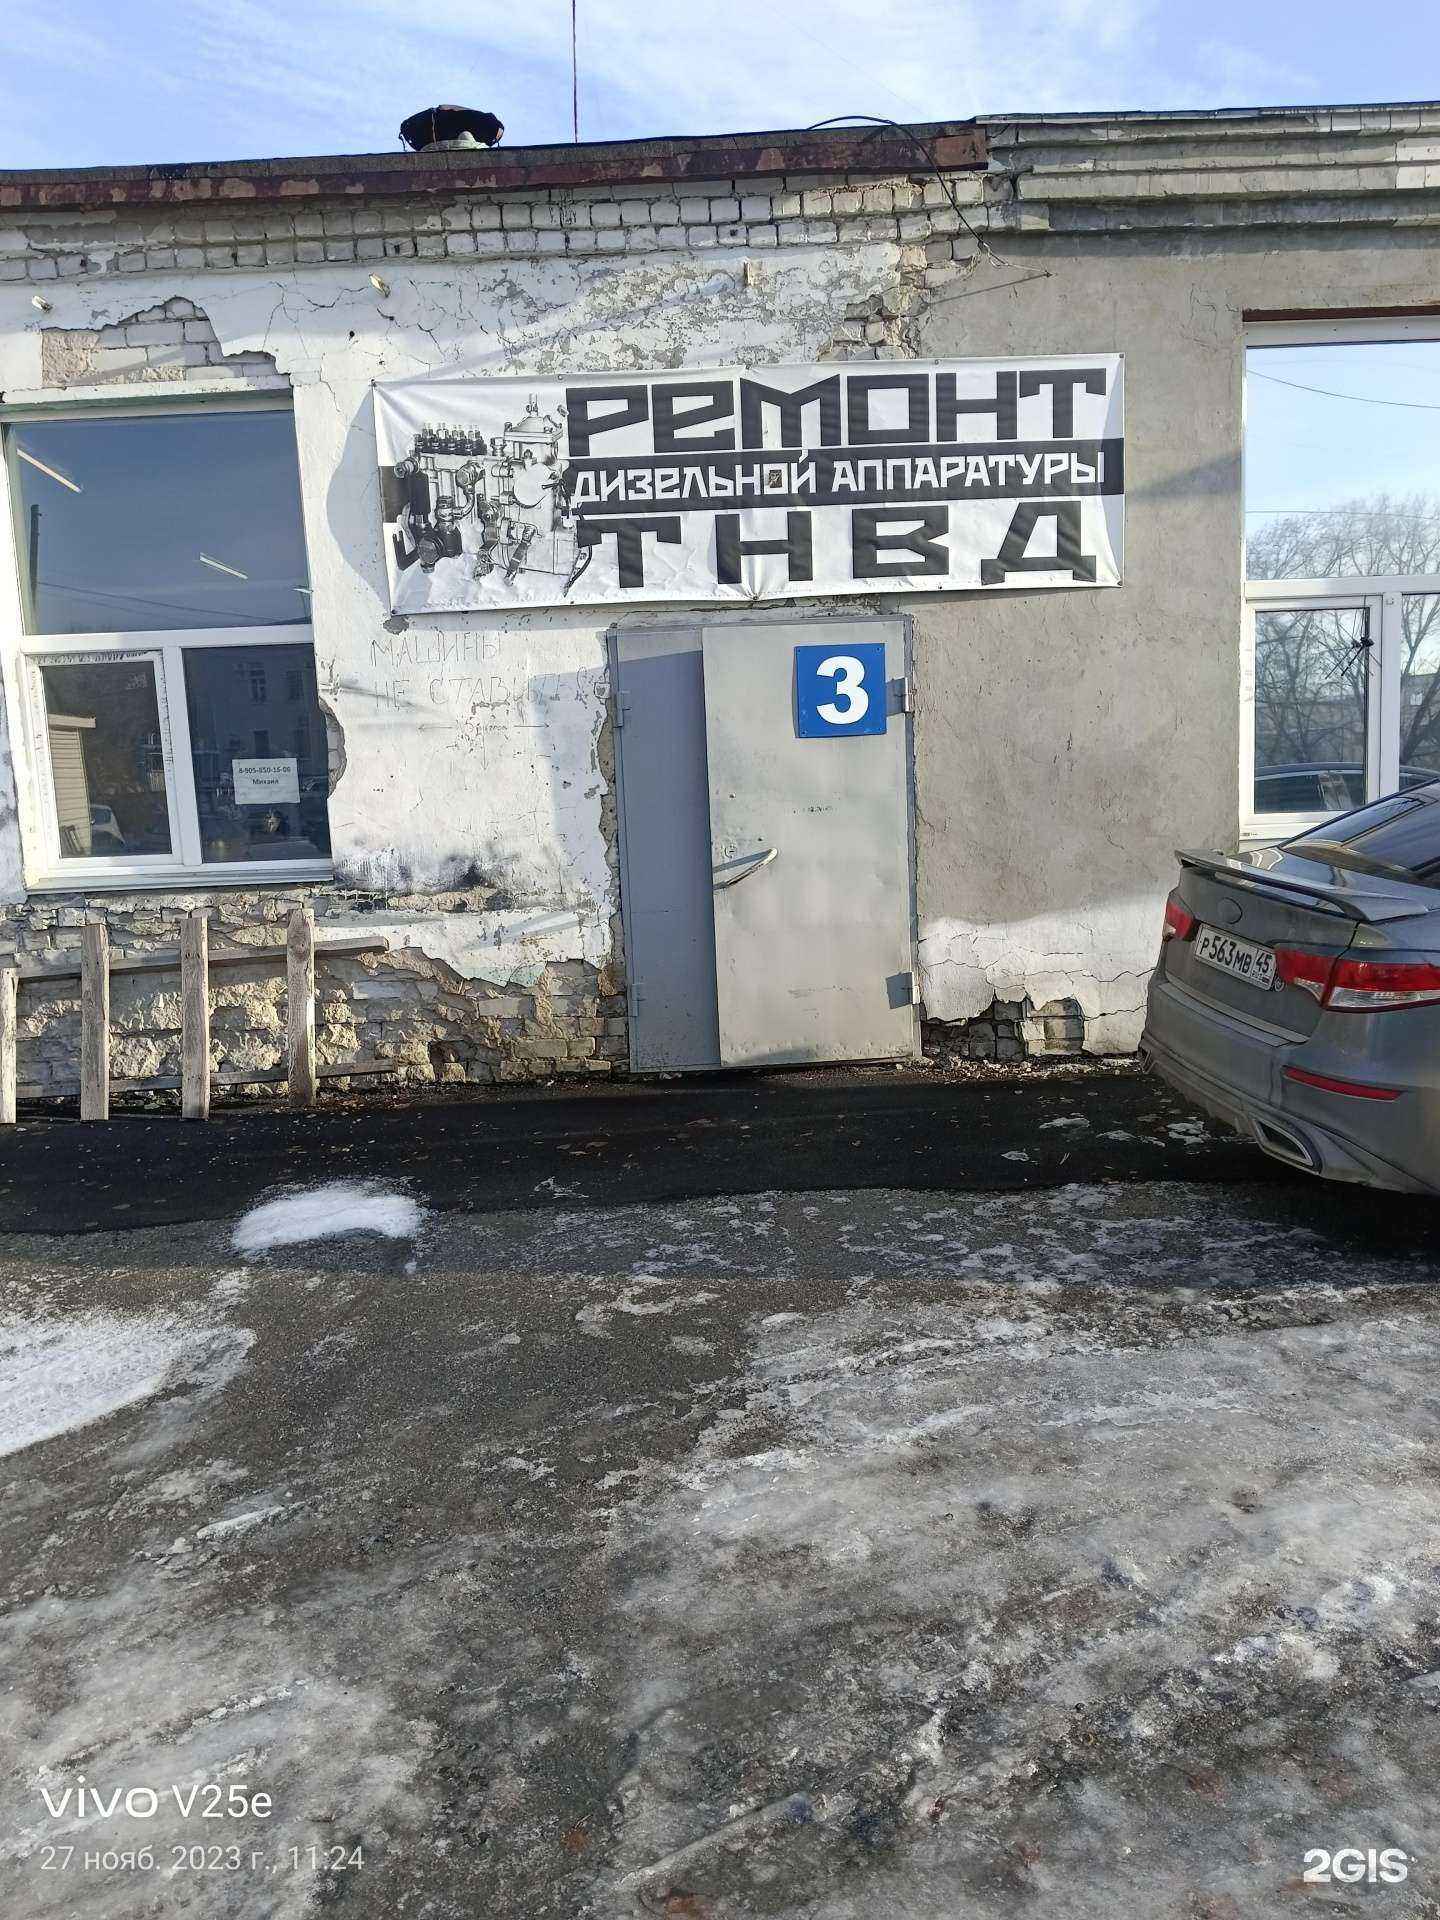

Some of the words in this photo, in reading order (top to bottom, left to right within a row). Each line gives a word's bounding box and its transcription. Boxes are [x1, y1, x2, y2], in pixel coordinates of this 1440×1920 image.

[566, 368, 1107, 457] РЕМОНТ
[571, 451, 817, 503] ДИЗЕЛЬНОЙ
[831, 451, 1105, 493] АППАРАТУРЫ
[577, 500, 1097, 588] ТНВД
[816, 655, 869, 725] 3
[1256, 952, 1273, 973] 45
